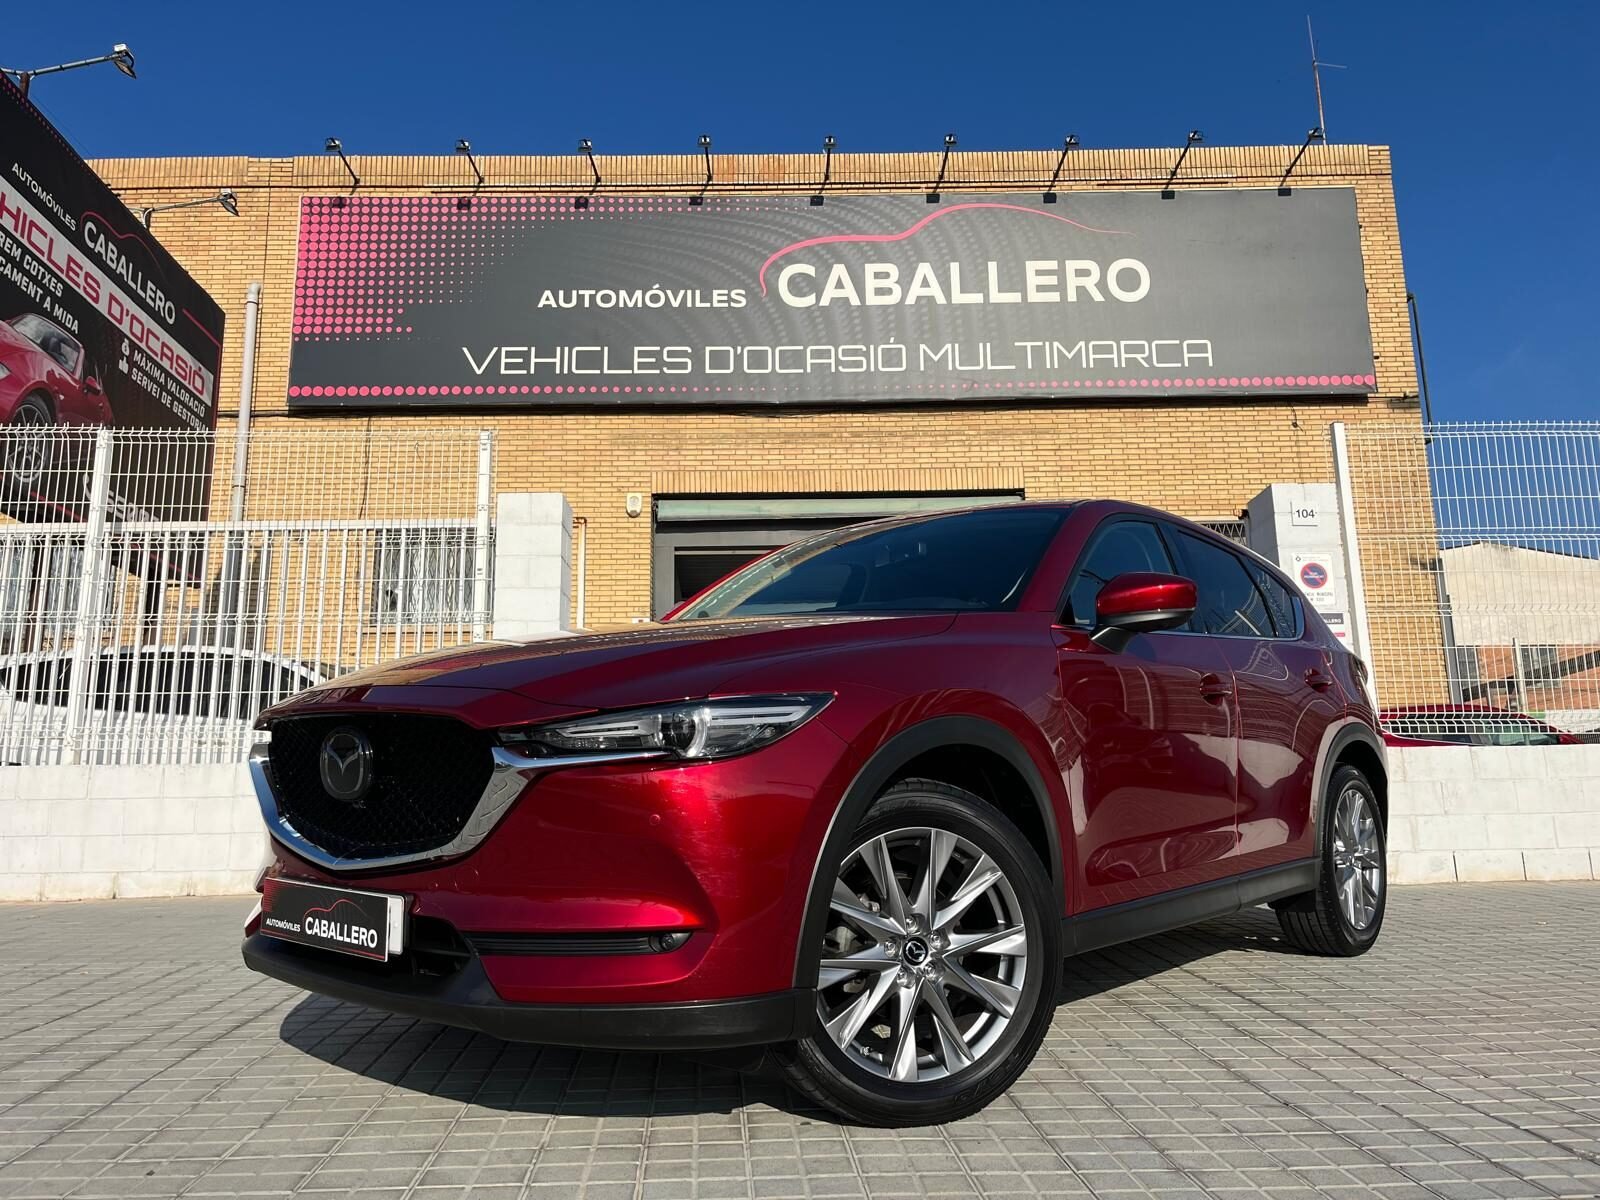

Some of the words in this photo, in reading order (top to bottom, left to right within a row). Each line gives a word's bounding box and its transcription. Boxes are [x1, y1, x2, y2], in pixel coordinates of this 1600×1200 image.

[12, 162, 77, 232] AUTOMÓVILES
[84, 221, 176, 325] CABALLERO
[23, 254, 64, 298] COTXES
[537, 283, 748, 309] AUTOMÓVILES
[777, 258, 1151, 308] CABALLERO
[43, 296, 51, 312] A
[53, 303, 79, 335] MIDA
[107, 291, 205, 396] D'OCASIÓ
[462, 346, 692, 375] VEHICLES
[705, 336, 907, 374] D'OCASIÓ
[131, 367, 161, 399] SERVEI
[161, 391, 173, 409] DE
[167, 377, 206, 418] VALORACIÓ
[1296, 509, 1315, 519] 104
[265, 917, 301, 933] AUTOMÓVILES
[305, 916, 378, 949] CABALLERO
